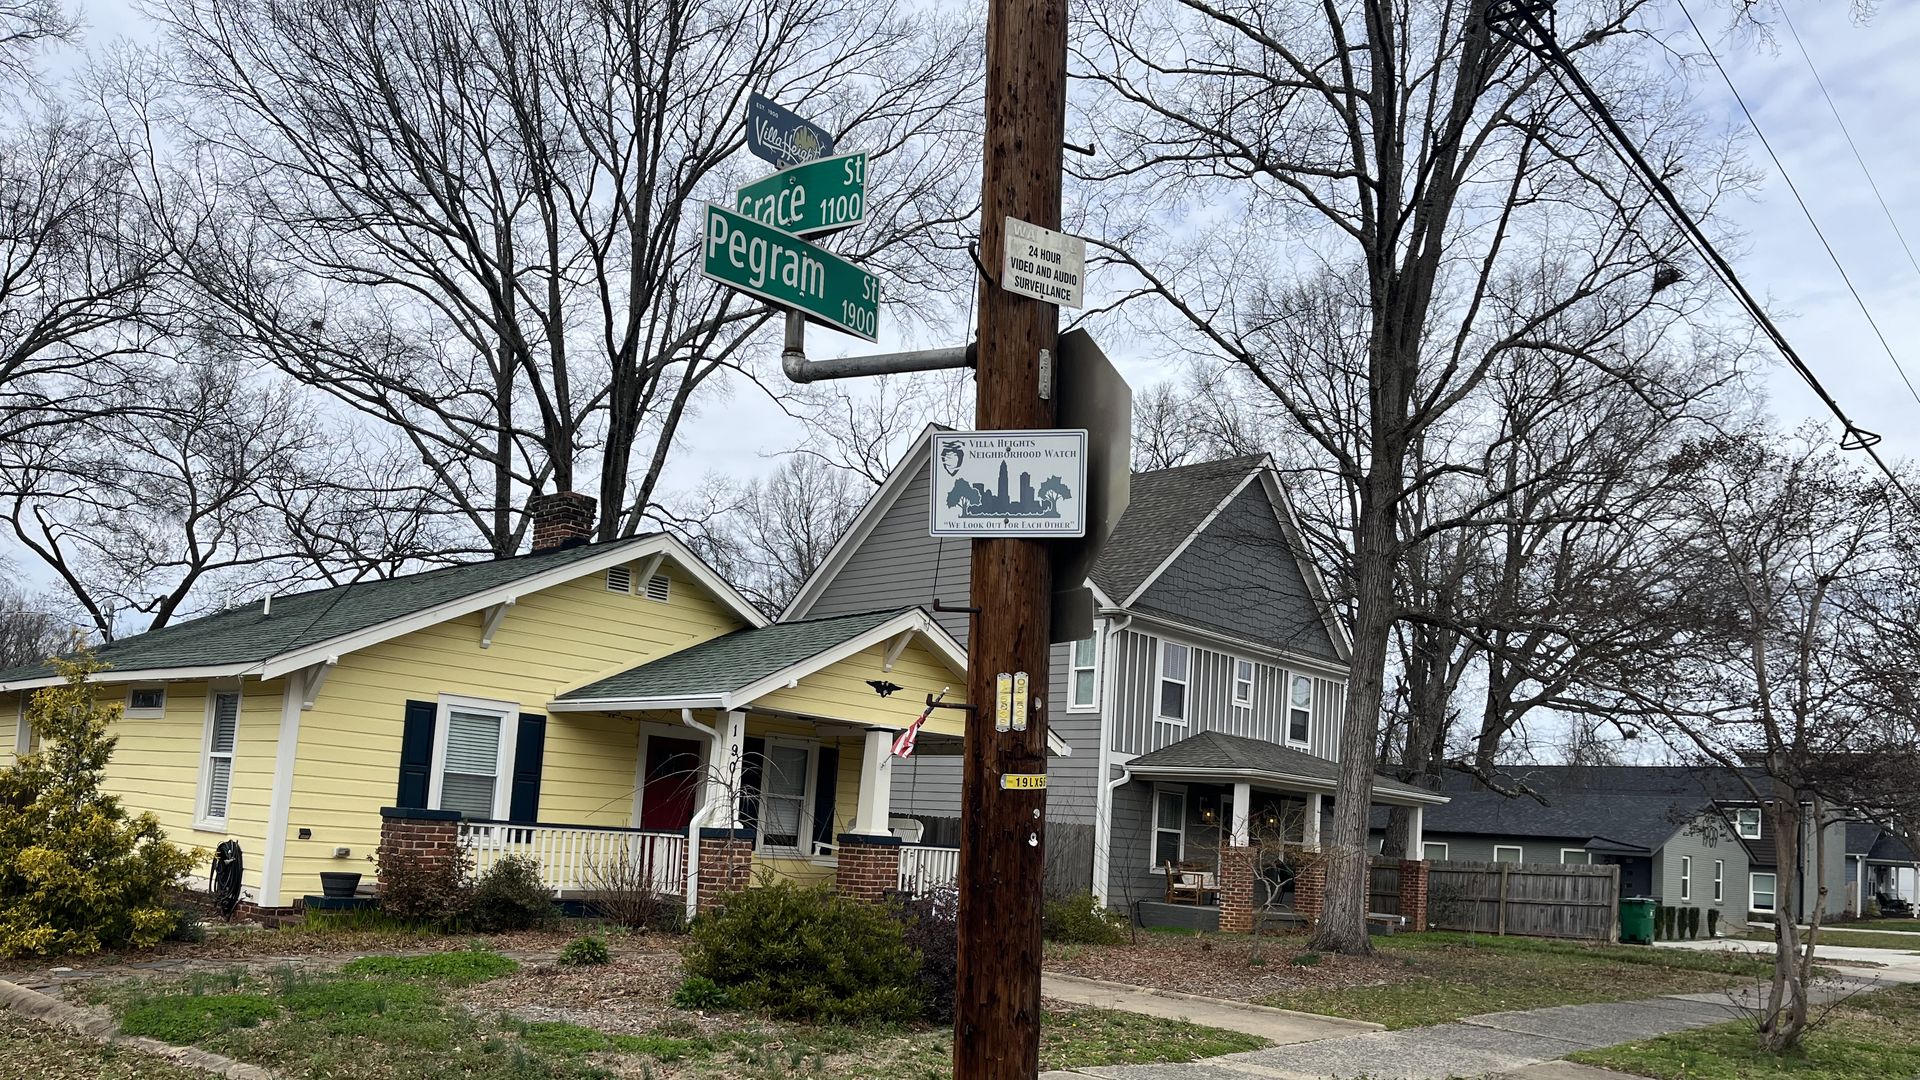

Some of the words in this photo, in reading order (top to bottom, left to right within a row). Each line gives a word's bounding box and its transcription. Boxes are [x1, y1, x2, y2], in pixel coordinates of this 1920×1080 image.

[756, 116, 781, 147] Villa
[844, 157, 863, 185] St
[820, 192, 861, 225] 1100
[709, 213, 825, 298] Pegram
[863, 276, 877, 303] St
[1029, 245, 1038, 258] 24
[1041, 249, 1061, 265] HOUR
[1010, 257, 1034, 274] VIDEO
[1036, 265, 1051, 278] AND
[1053, 270, 1077, 286] AUDIO
[1014, 275, 1071, 301] SURVEILLANCE
[841, 299, 875, 336] 1900
